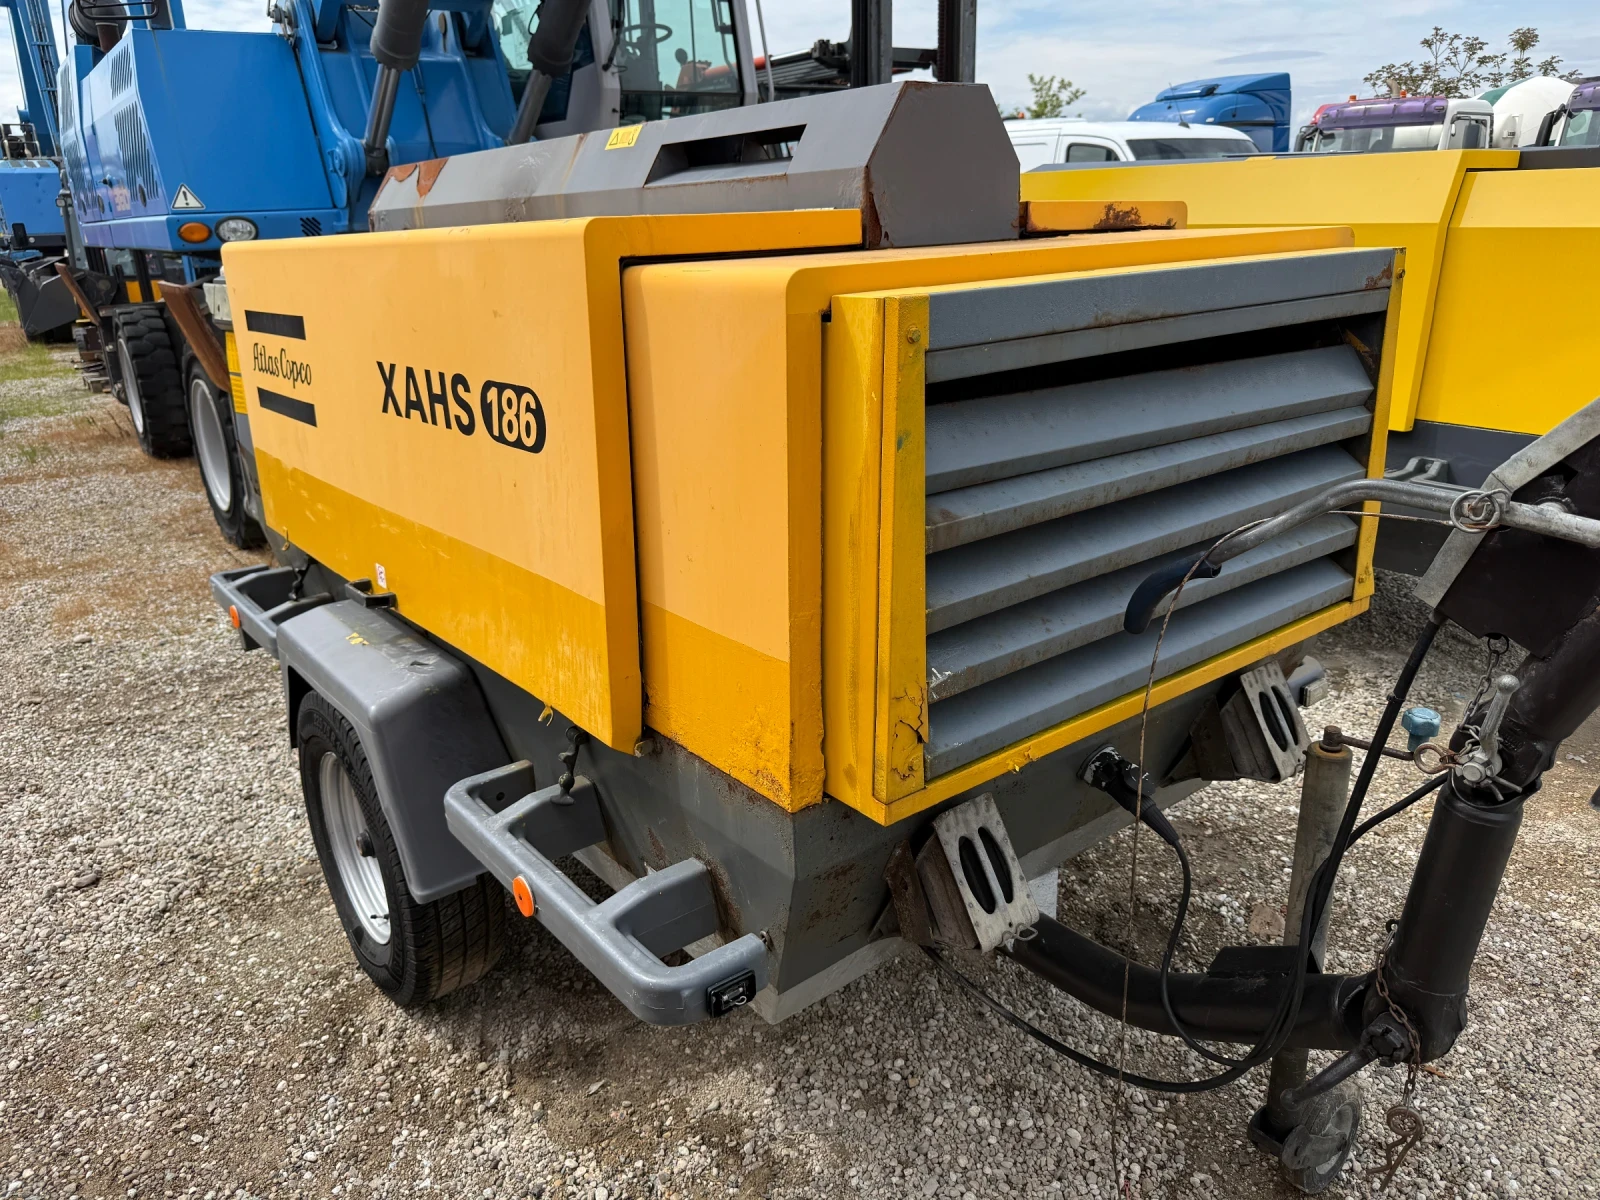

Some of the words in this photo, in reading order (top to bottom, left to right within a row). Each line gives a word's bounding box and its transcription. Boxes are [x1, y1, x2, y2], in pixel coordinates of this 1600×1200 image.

[253, 342, 280, 378] Atlas
[280, 347, 313, 389] Copco
[375, 360, 476, 436] XAHS
[486, 386, 537, 447] 186
